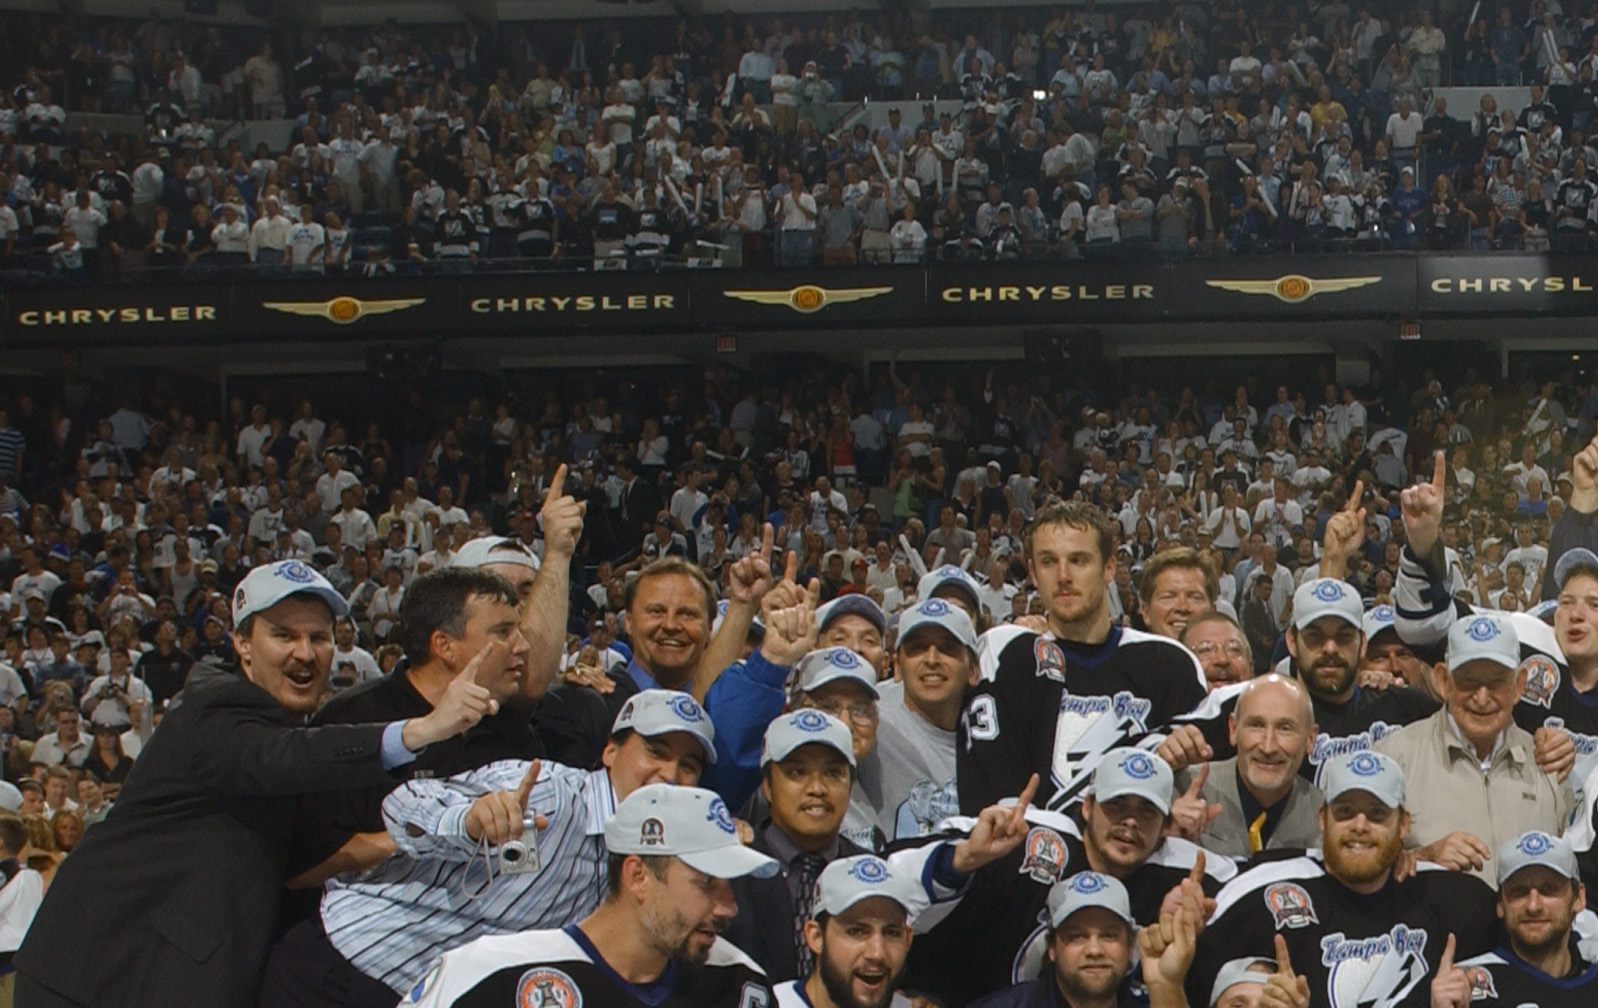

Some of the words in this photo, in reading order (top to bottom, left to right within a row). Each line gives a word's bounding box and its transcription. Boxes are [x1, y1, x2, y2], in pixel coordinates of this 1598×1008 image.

[942, 285, 1154, 302] CHRYSLER
[471, 294, 674, 312] CHRYSLER
[19, 306, 216, 325] CHRYSLER
[1322, 934, 1392, 963] Tampa
[1392, 925, 1426, 959] Bay
